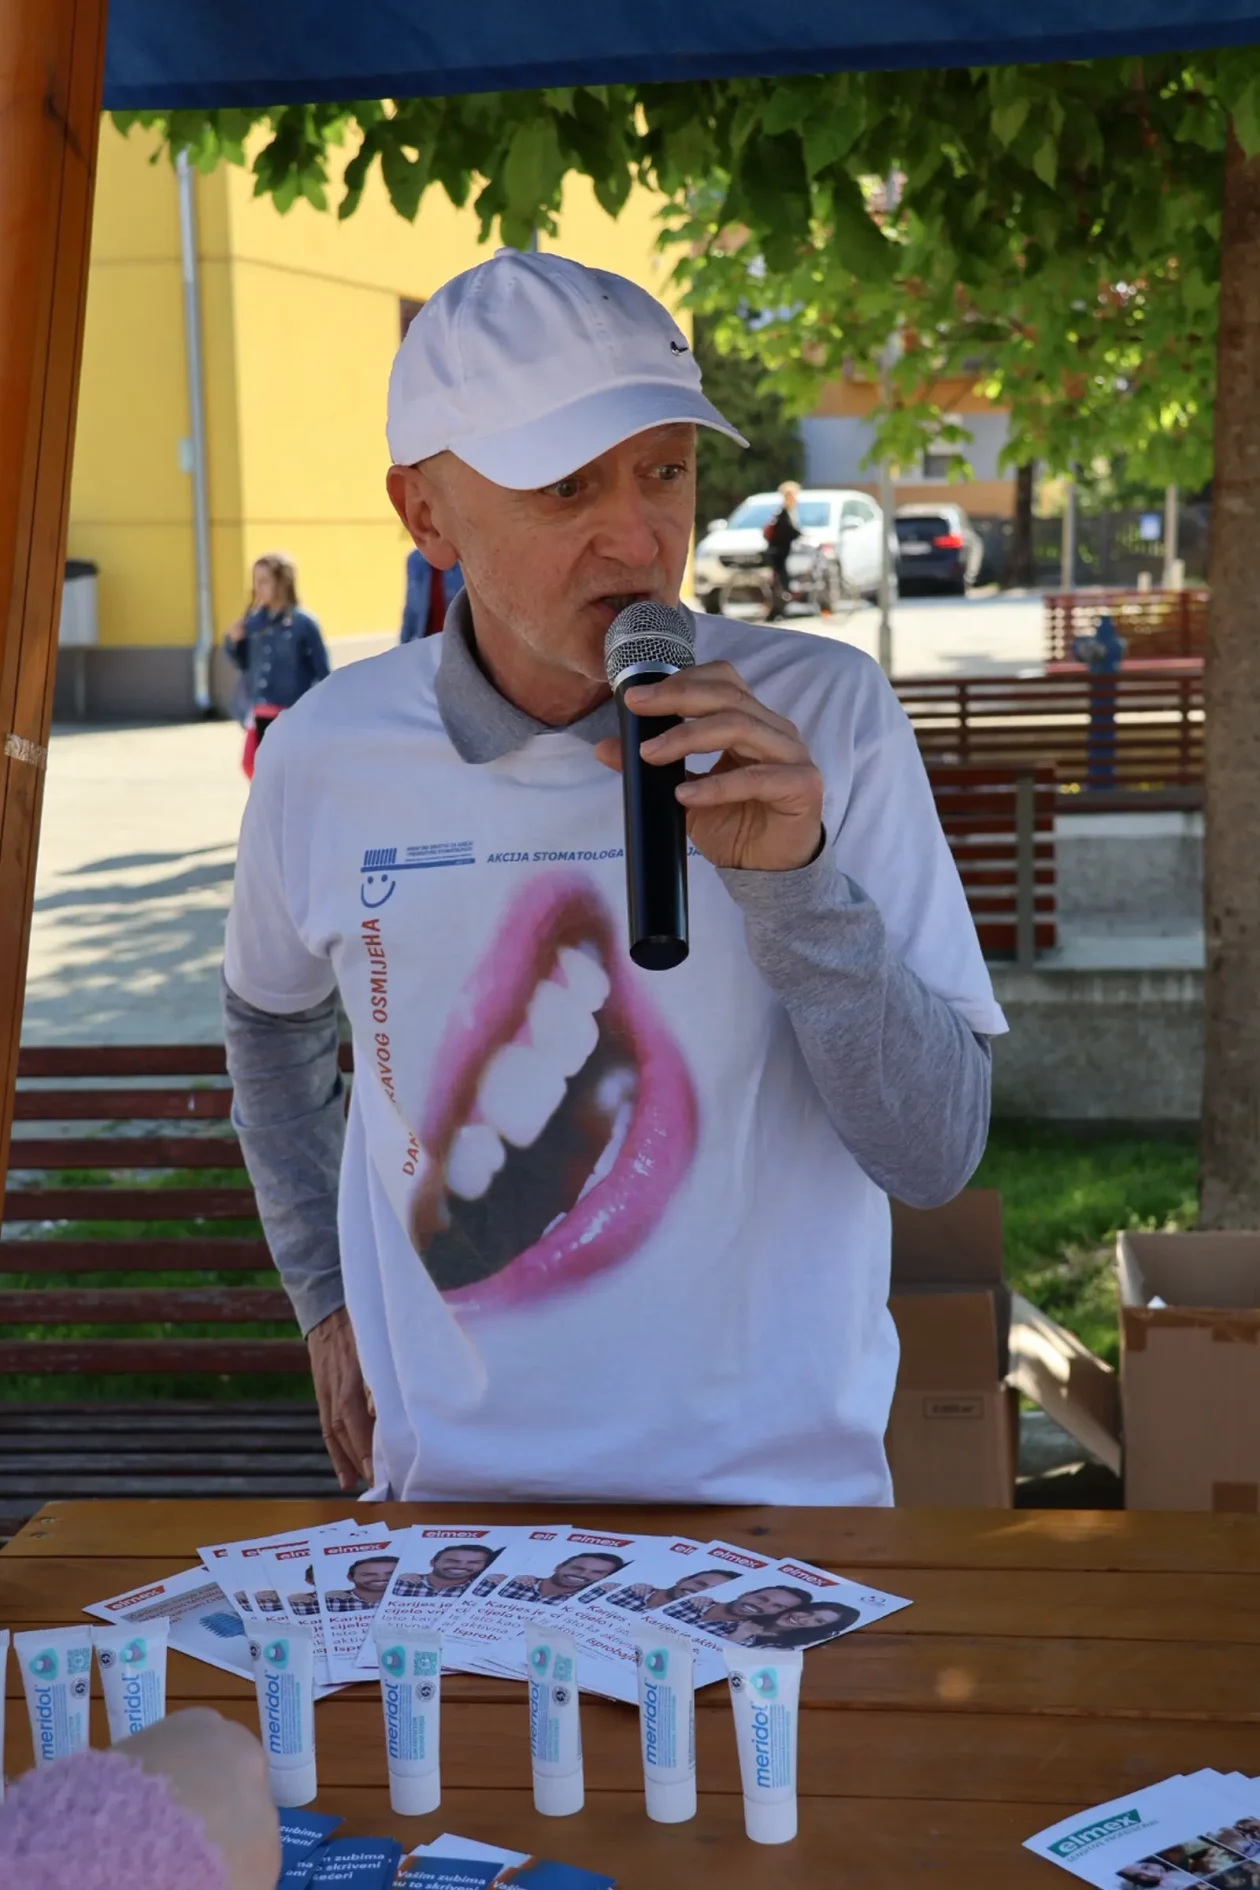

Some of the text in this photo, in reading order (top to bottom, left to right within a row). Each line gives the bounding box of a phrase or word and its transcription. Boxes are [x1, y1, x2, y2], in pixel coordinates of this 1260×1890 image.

[486, 851, 529, 864] AKCIJA
[532, 849, 625, 862] STOMATOLOGA
[361, 918, 388, 1024] OSMIJEHA
[425, 1530, 480, 1539] elmex
[570, 1535, 621, 1548] elmex
[279, 1548, 311, 1560] elm
[328, 1543, 381, 1554] elmex
[713, 1549, 758, 1569] elmex
[782, 1565, 828, 1587] elmex
[332, 1637, 367, 1645] aktiv
[122, 1674, 143, 1735] eridol
[265, 1673, 282, 1754] meridol
[35, 1686, 54, 1761] meridol
[384, 1683, 399, 1759] meridol
[644, 1683, 659, 1766] meridol
[753, 1704, 772, 1789] meridol
[1058, 1814, 1139, 1853] elmex
[325, 1861, 381, 1871] skriveni
[334, 1853, 385, 1862] zubima
[397, 1870, 486, 1885] Vašim zubima
